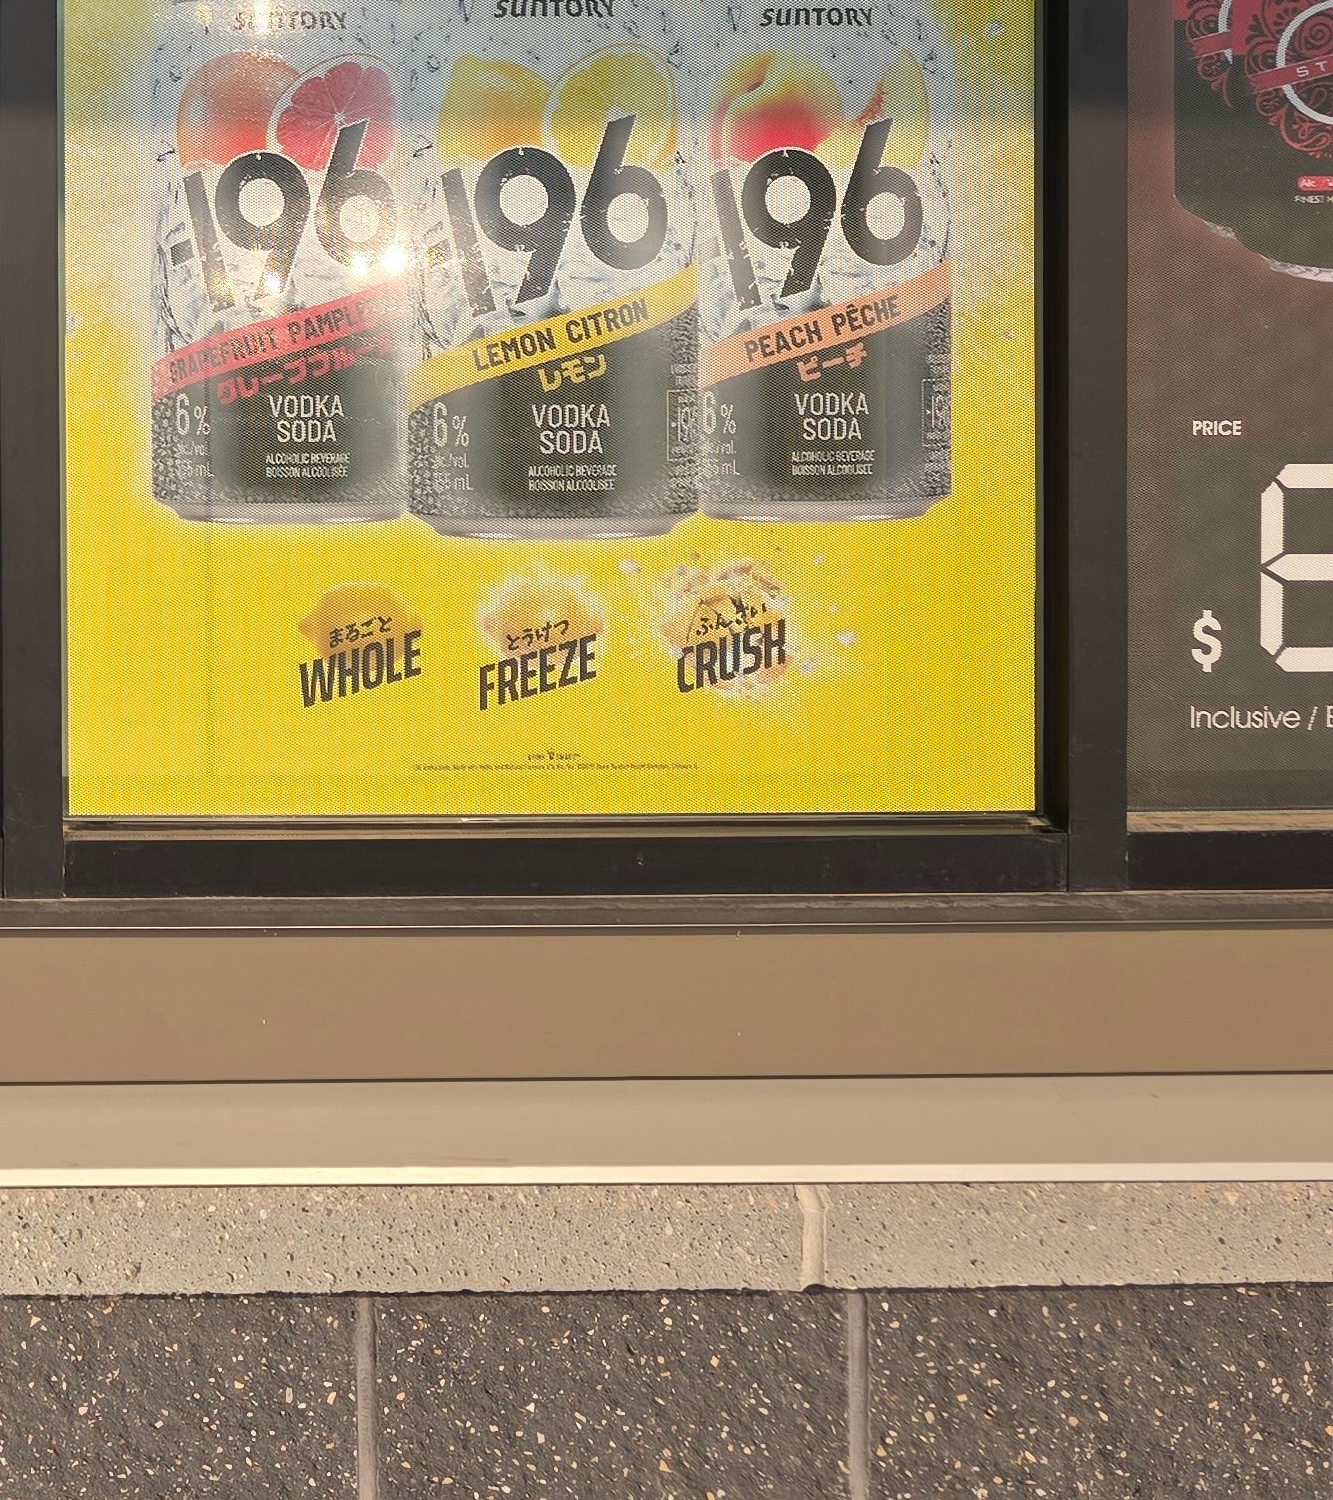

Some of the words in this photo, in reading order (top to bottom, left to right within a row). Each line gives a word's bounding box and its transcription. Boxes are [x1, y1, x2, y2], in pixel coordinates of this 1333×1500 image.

[232, 10, 349, 31] SNTORY
[759, 6, 873, 28] SUNTORY
[183, 117, 397, 312] 196
[441, 112, 668, 317] 196
[710, 116, 924, 311] 196
[472, 327, 557, 372] LEMON
[564, 299, 650, 343] CITRON
[744, 320, 823, 363] PEACH
[830, 294, 903, 337] PÊCHE
[169, 329, 278, 384] GRAPEFRUIT
[538, 353, 608, 393] レモン
[796, 341, 868, 383] ピーチ
[268, 394, 345, 418] VODKA
[433, 401, 448, 448] 6
[531, 403, 612, 428] VODKA
[702, 391, 717, 435] 6
[794, 392, 870, 416] VODKA
[276, 420, 337, 443] SODA
[539, 429, 604, 455] SODA
[802, 416, 863, 441] SODA
[1191, 420, 1243, 437] PRICE
[327, 614, 394, 649] まるごと
[504, 619, 571, 652] とうけつ
[1190, 608, 1222, 673] $
[298, 628, 424, 709] WHOLE
[478, 632, 598, 712] FREEZE
[675, 618, 788, 695] CRUSH
[1190, 705, 1301, 730] Inclusive
